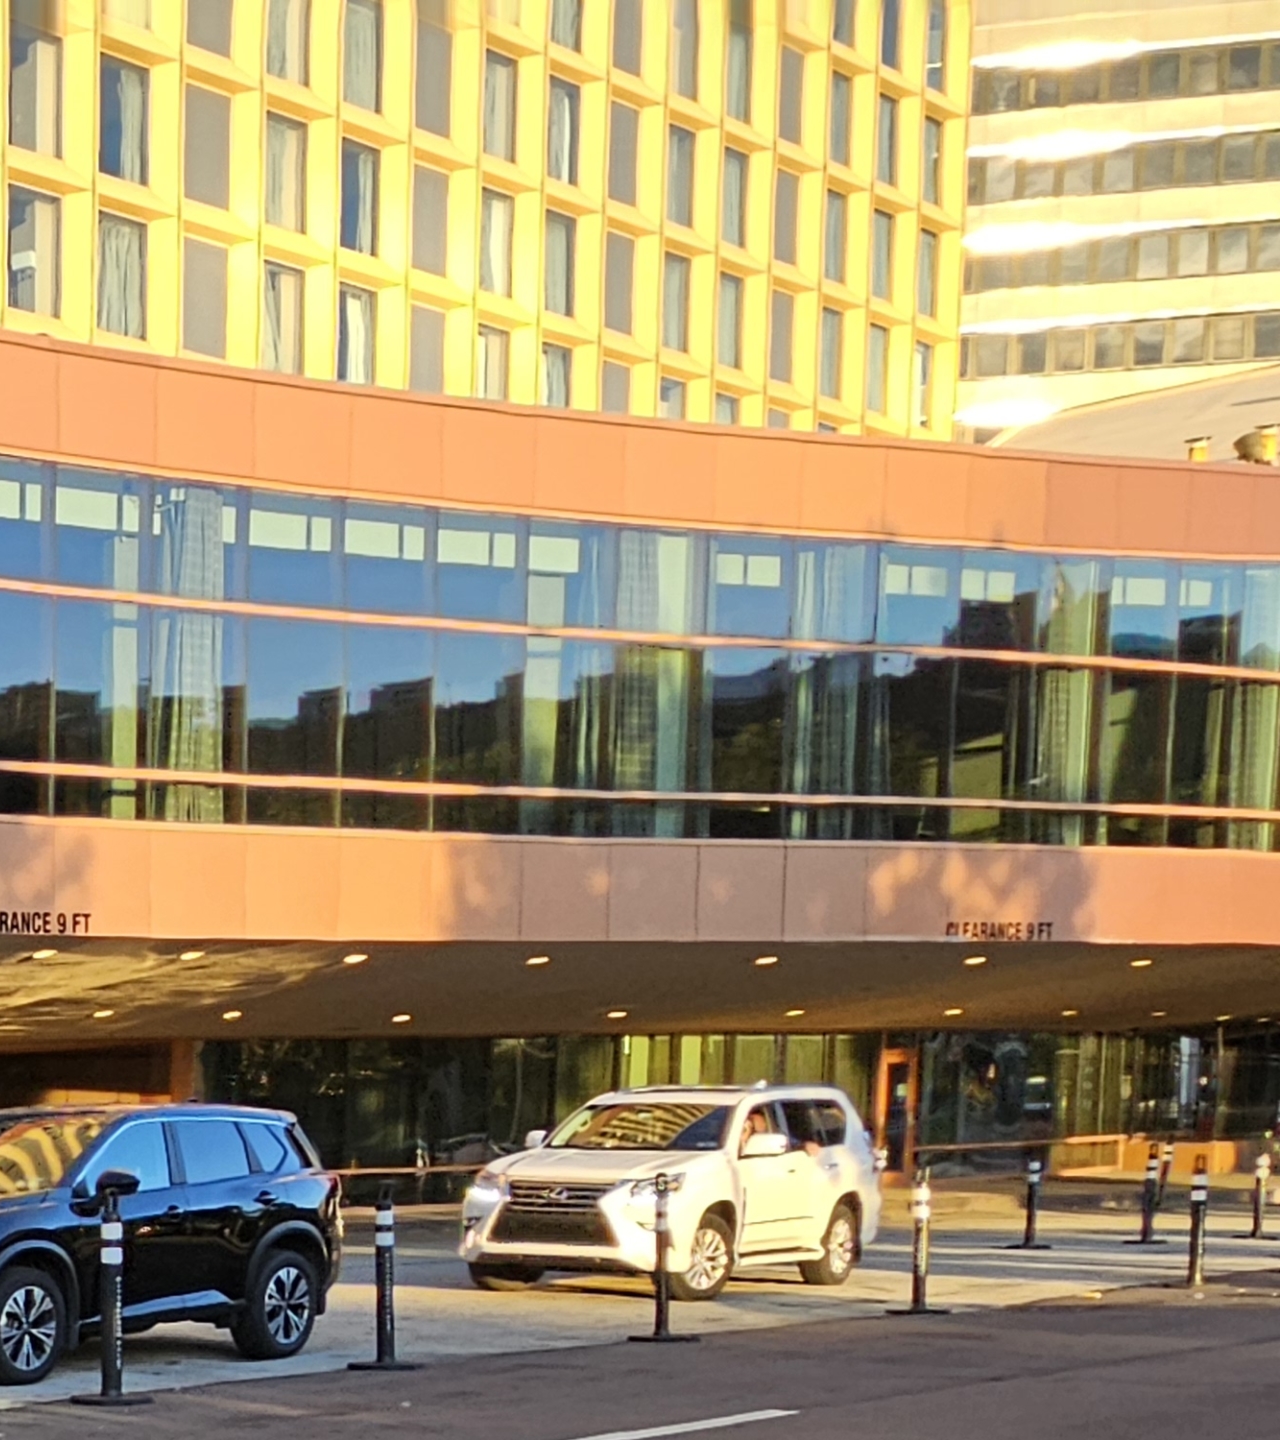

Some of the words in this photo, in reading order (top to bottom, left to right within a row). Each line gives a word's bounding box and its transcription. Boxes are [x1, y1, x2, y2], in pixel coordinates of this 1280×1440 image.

[57, 913, 67, 933] 9
[72, 913, 92, 933] FT
[1026, 922, 1035, 940] 9
[1038, 922, 1053, 940] FT
